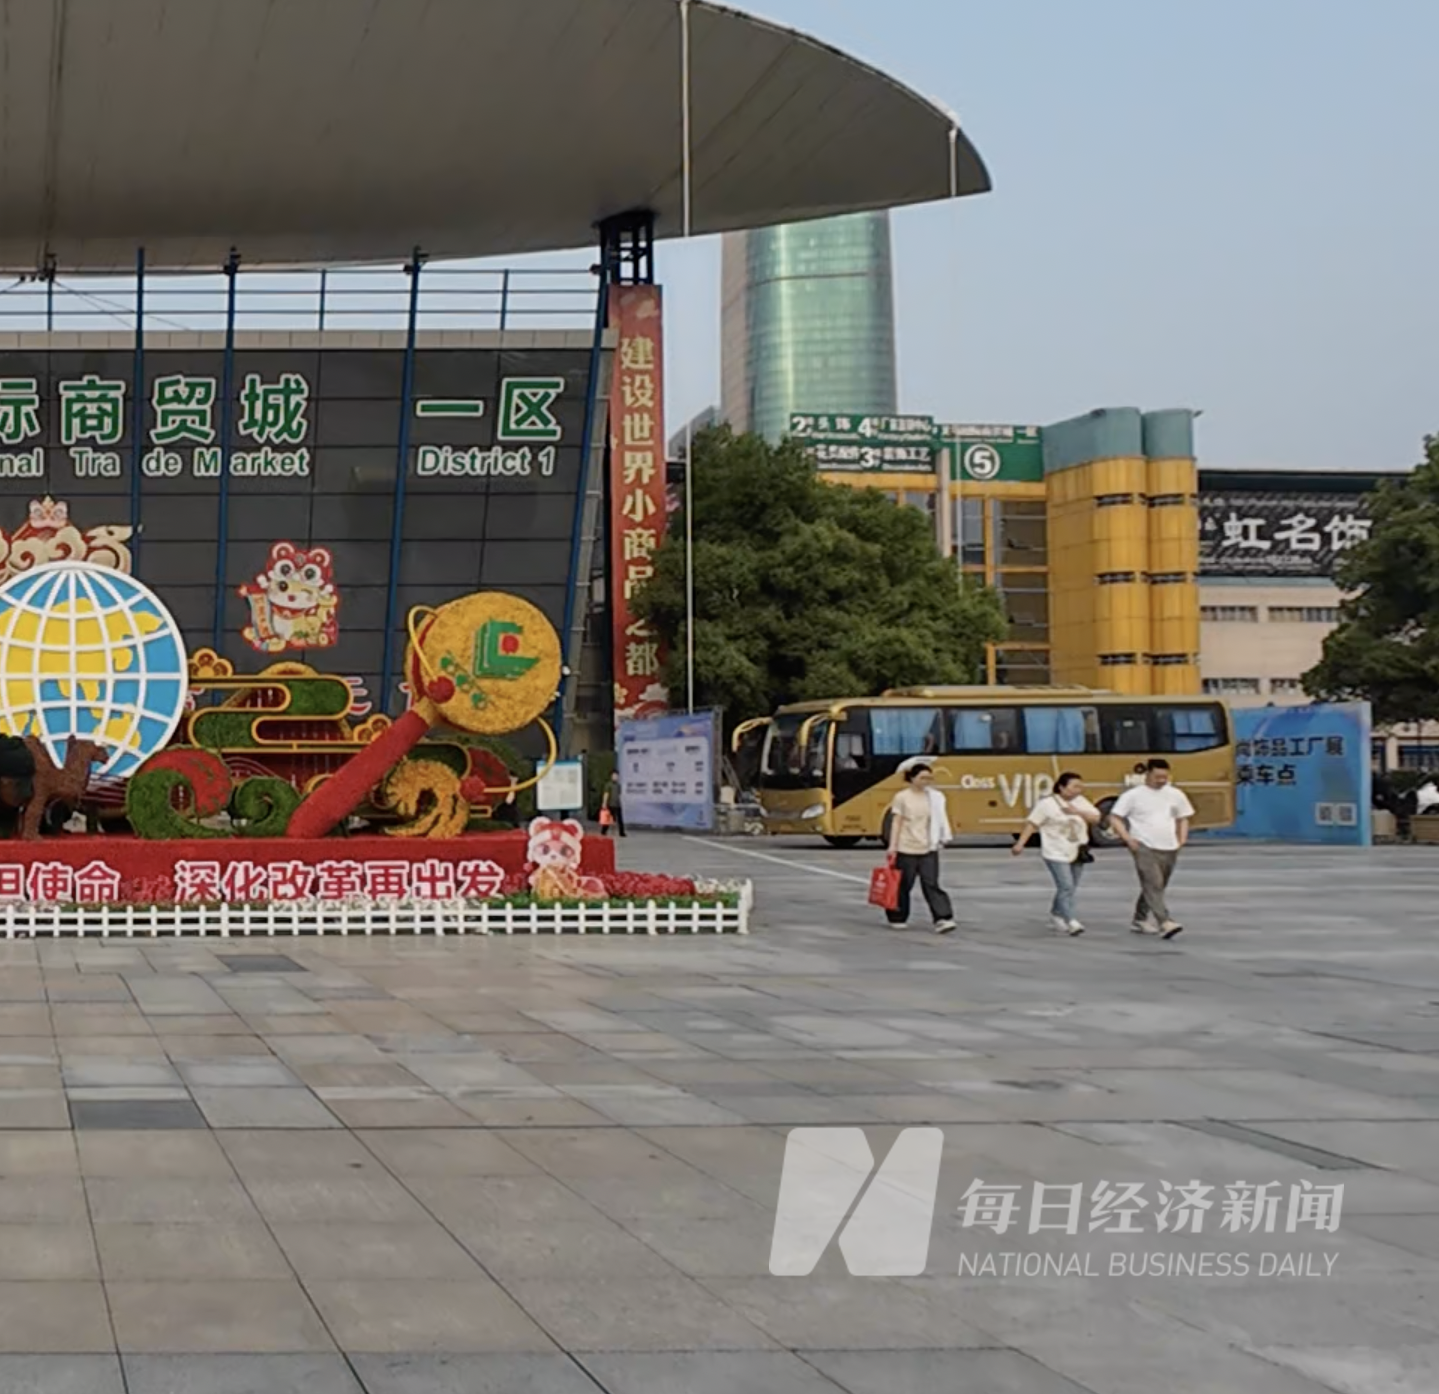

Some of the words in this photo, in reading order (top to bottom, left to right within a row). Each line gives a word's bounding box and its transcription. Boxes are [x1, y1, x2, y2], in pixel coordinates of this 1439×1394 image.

[416, 377, 564, 441] 一区
[416, 445, 531, 476] District
[539, 445, 556, 476] 1
[997, 772, 1055, 809] VIP
[173, 858, 506, 901] 深化改革再出发
